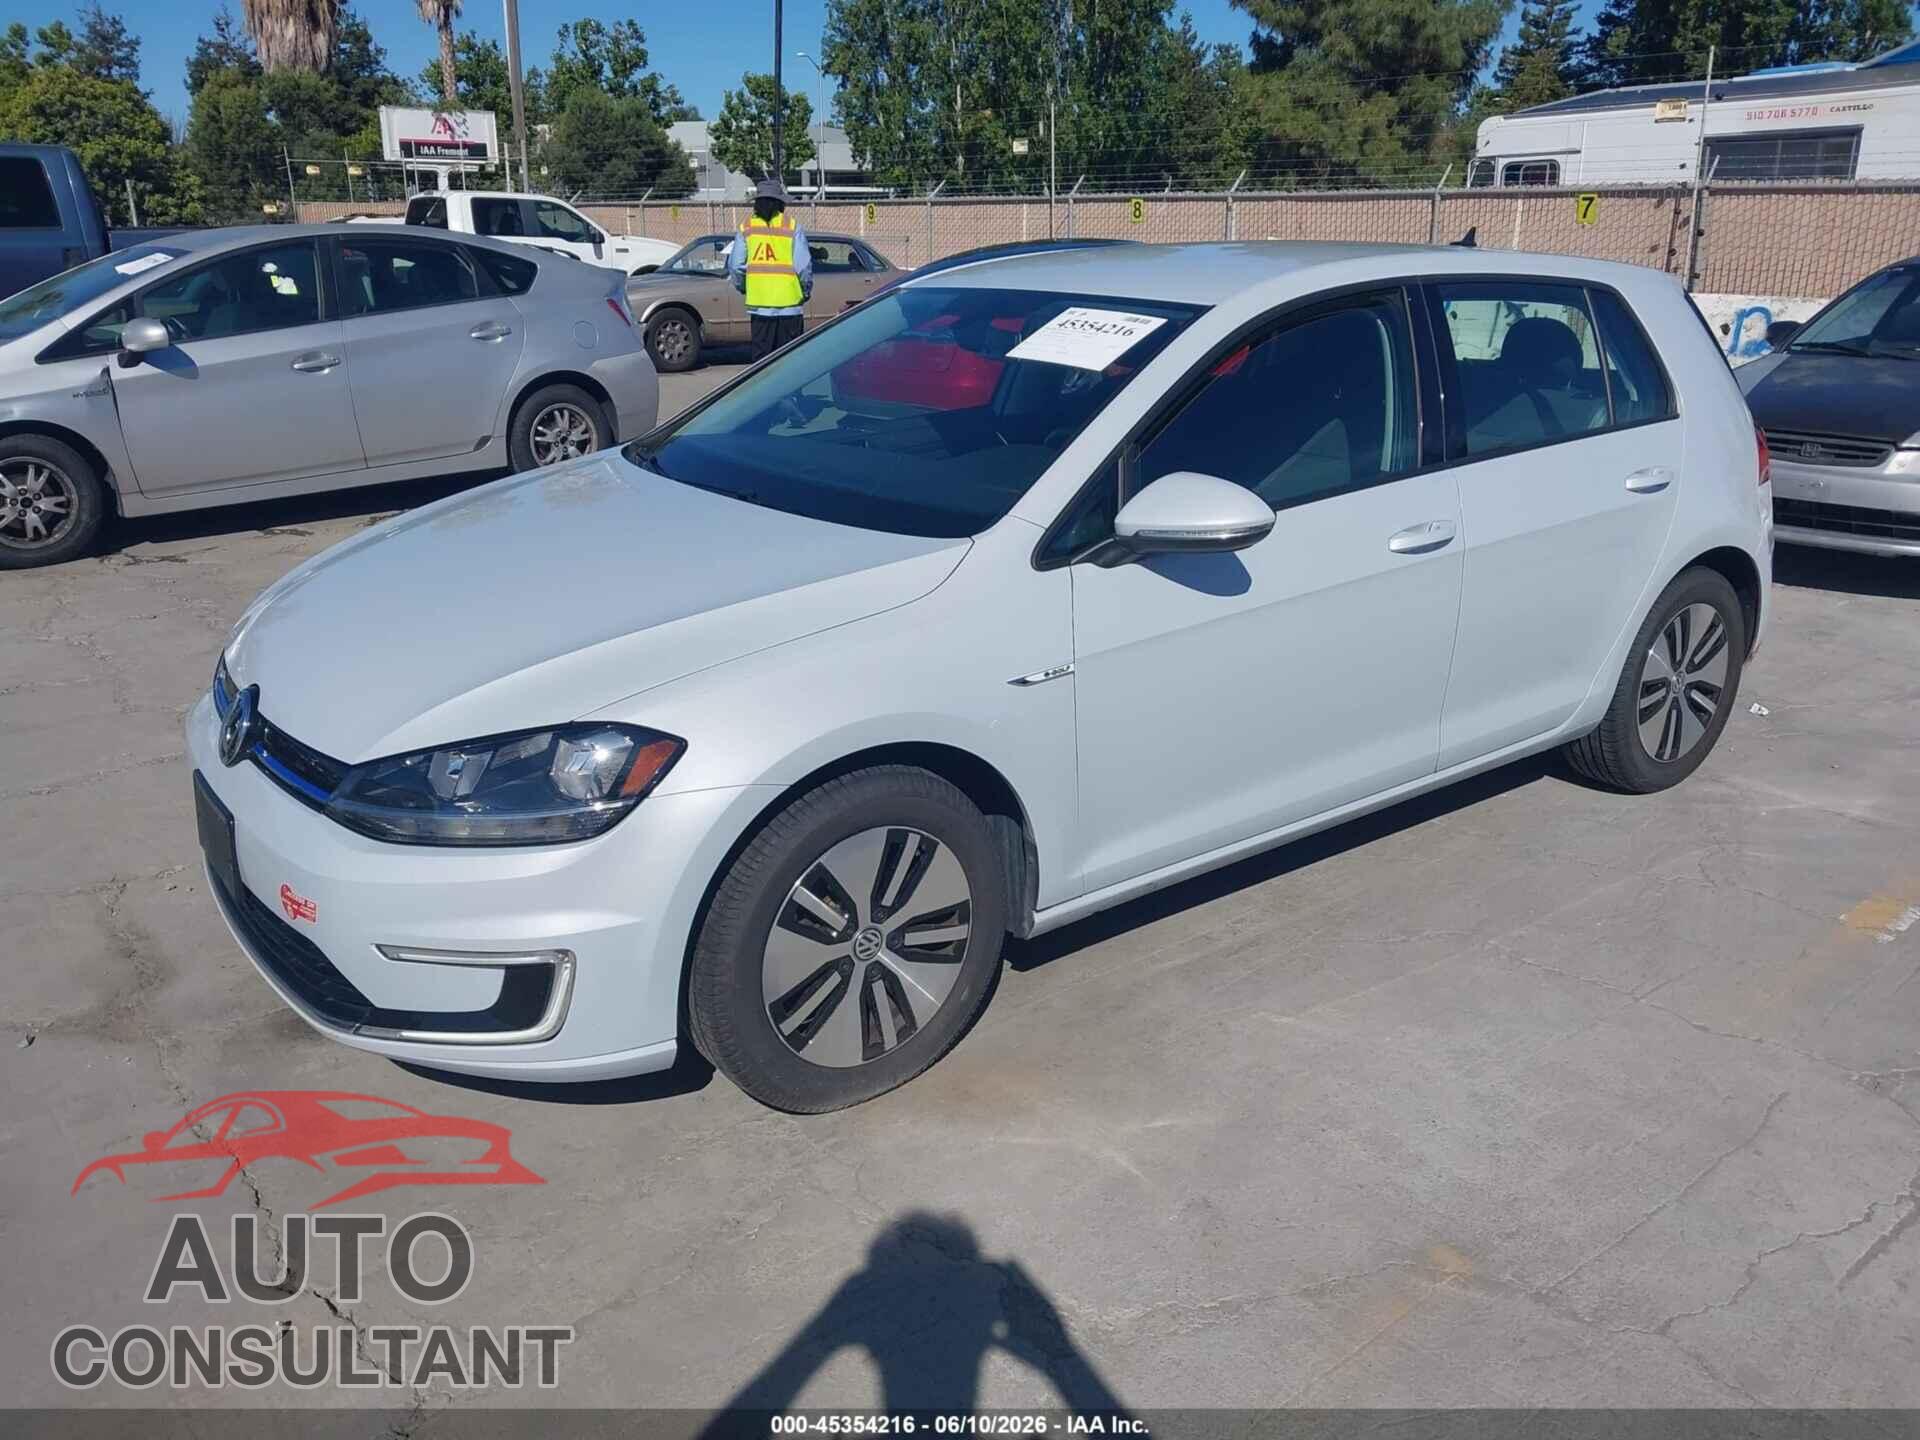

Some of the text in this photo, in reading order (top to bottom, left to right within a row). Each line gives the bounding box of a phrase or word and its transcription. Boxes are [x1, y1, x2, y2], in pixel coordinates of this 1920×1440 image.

[867, 205, 875, 220] 9
[1133, 201, 1142, 219] 8
[1582, 197, 1595, 219] 7
[1057, 319, 1135, 336] 45354216
